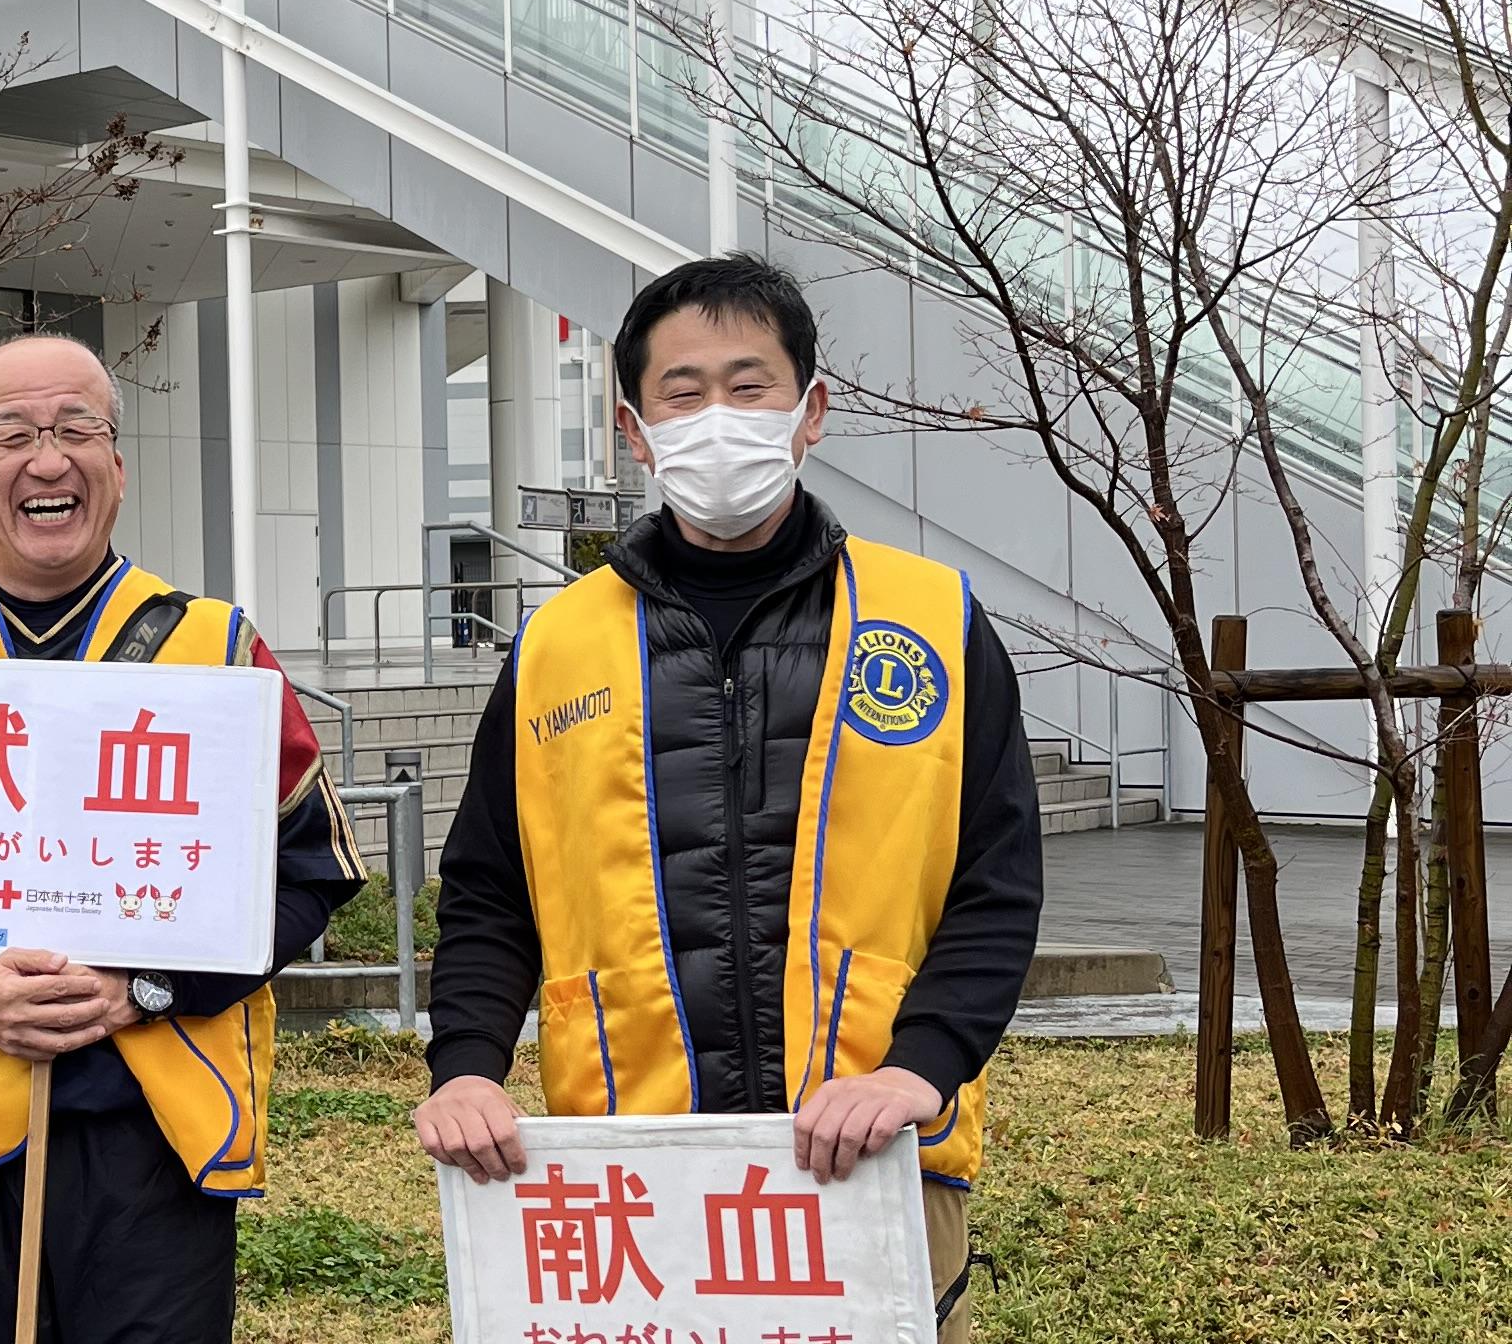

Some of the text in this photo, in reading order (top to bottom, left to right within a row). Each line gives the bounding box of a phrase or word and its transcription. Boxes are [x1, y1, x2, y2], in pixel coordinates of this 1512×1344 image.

[863, 632, 923, 662] LIONS
[876, 658, 904, 699] L
[528, 686, 611, 746] Y.YAMAMOTO
[854, 698, 915, 726] INTERNATIONAL
[26, 889, 102, 906] 日本赤十字社
[514, 1163, 845, 1305] 献血
